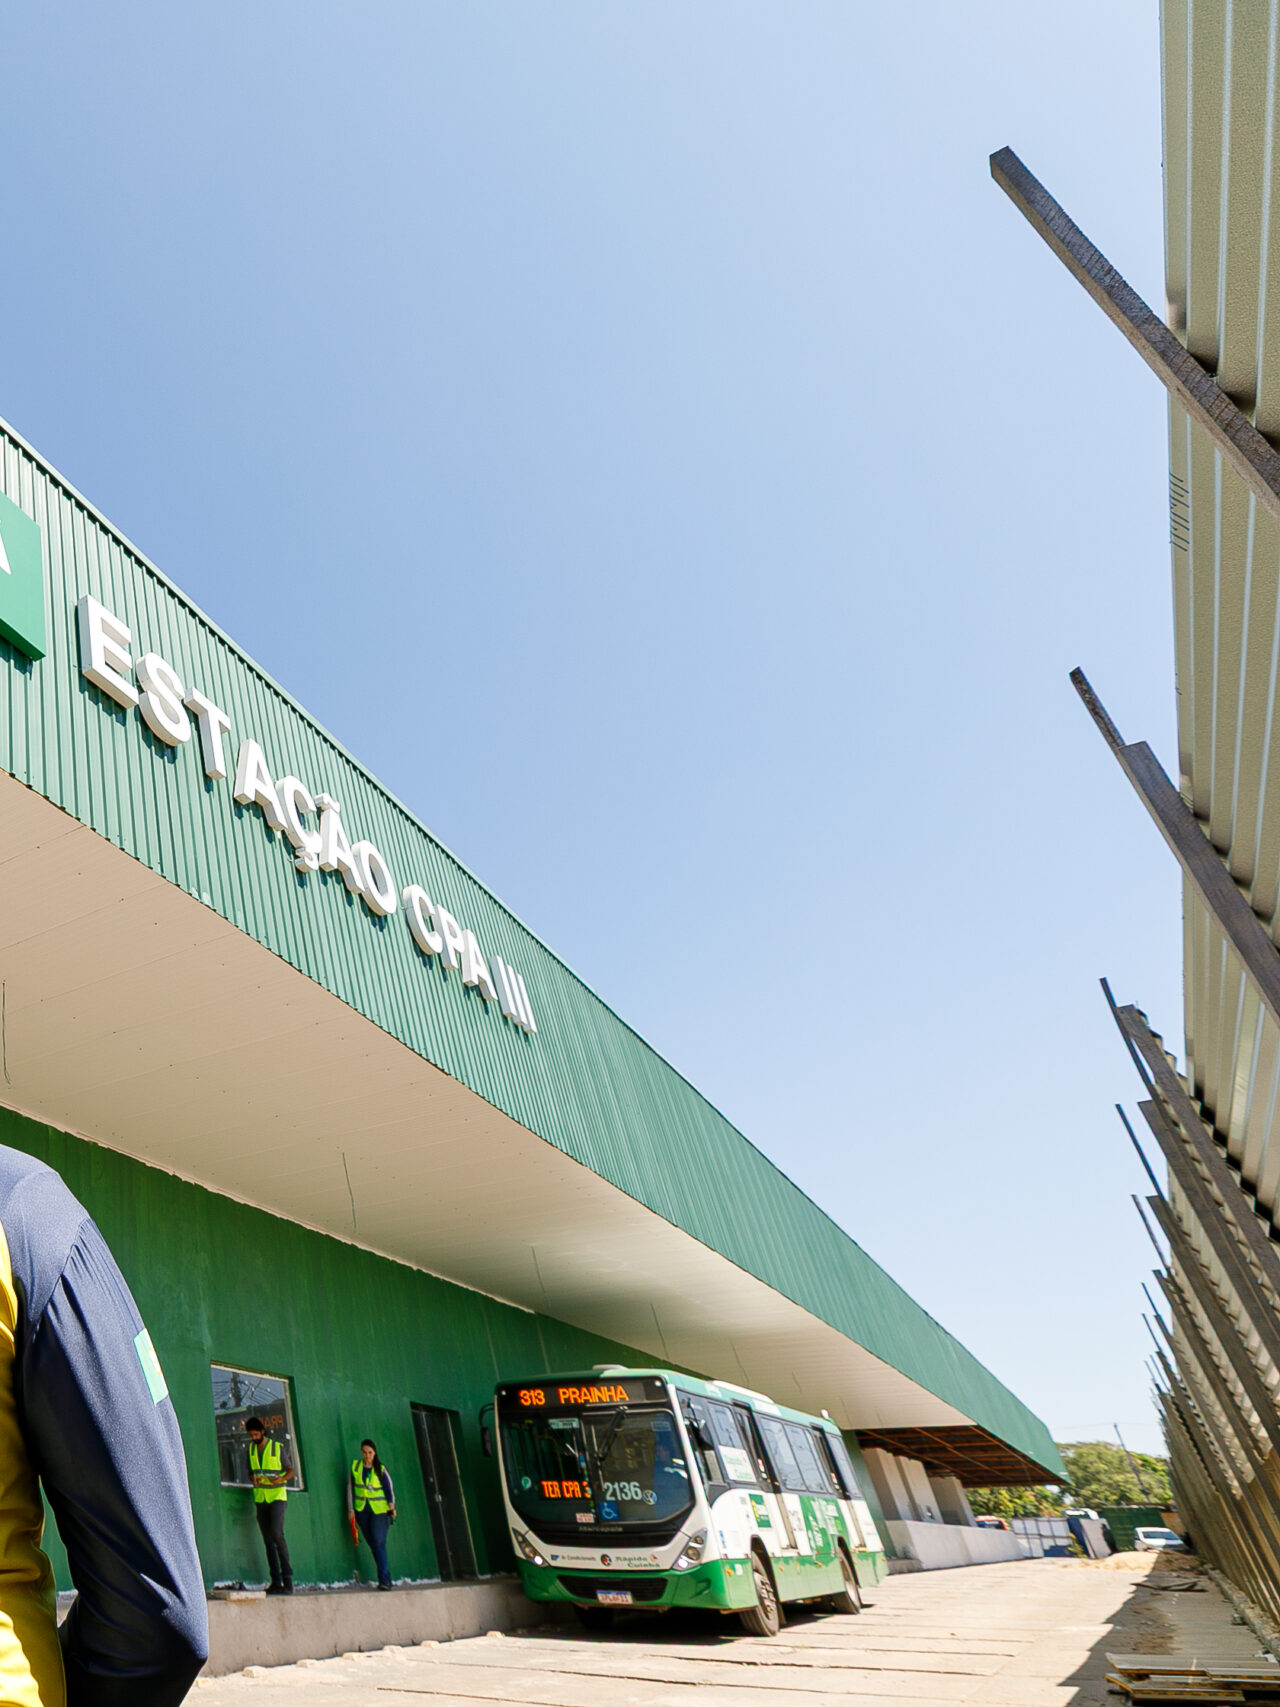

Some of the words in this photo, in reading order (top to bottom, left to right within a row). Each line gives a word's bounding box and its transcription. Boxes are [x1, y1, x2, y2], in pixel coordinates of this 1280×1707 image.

[77, 594, 397, 917] ESTAÇÃO
[402, 883, 498, 1002] CPA
[489, 954, 537, 1035] III
[518, 1387, 546, 1406] 313
[557, 1384, 630, 1404] PRAINHA
[541, 1480, 561, 1499] TER
[561, 1480, 582, 1499] CPA
[604, 1481, 643, 1501] 2136
